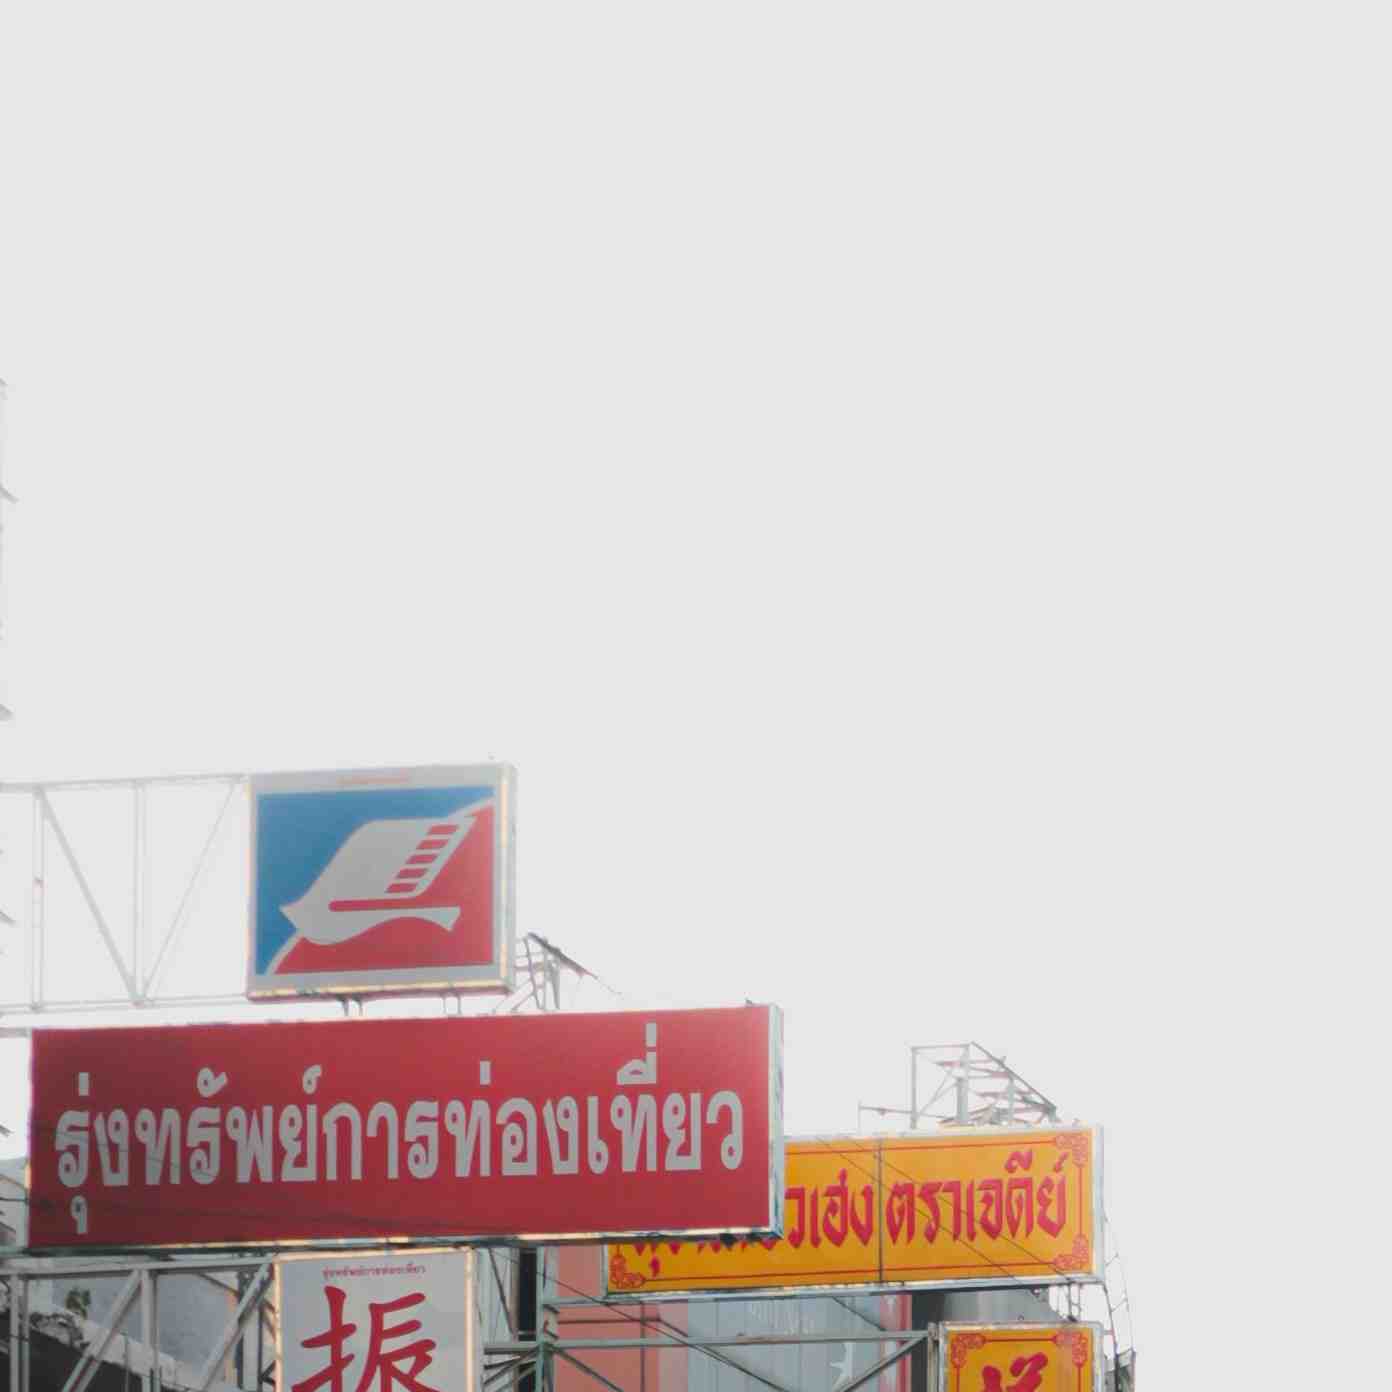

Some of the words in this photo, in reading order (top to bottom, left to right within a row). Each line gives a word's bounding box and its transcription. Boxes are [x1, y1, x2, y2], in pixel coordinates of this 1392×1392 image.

[53, 1022, 744, 1235] รุ่งทรัพย์การท่องเที่ยว
[886, 1149, 1069, 1246] ตราเจดีย์
